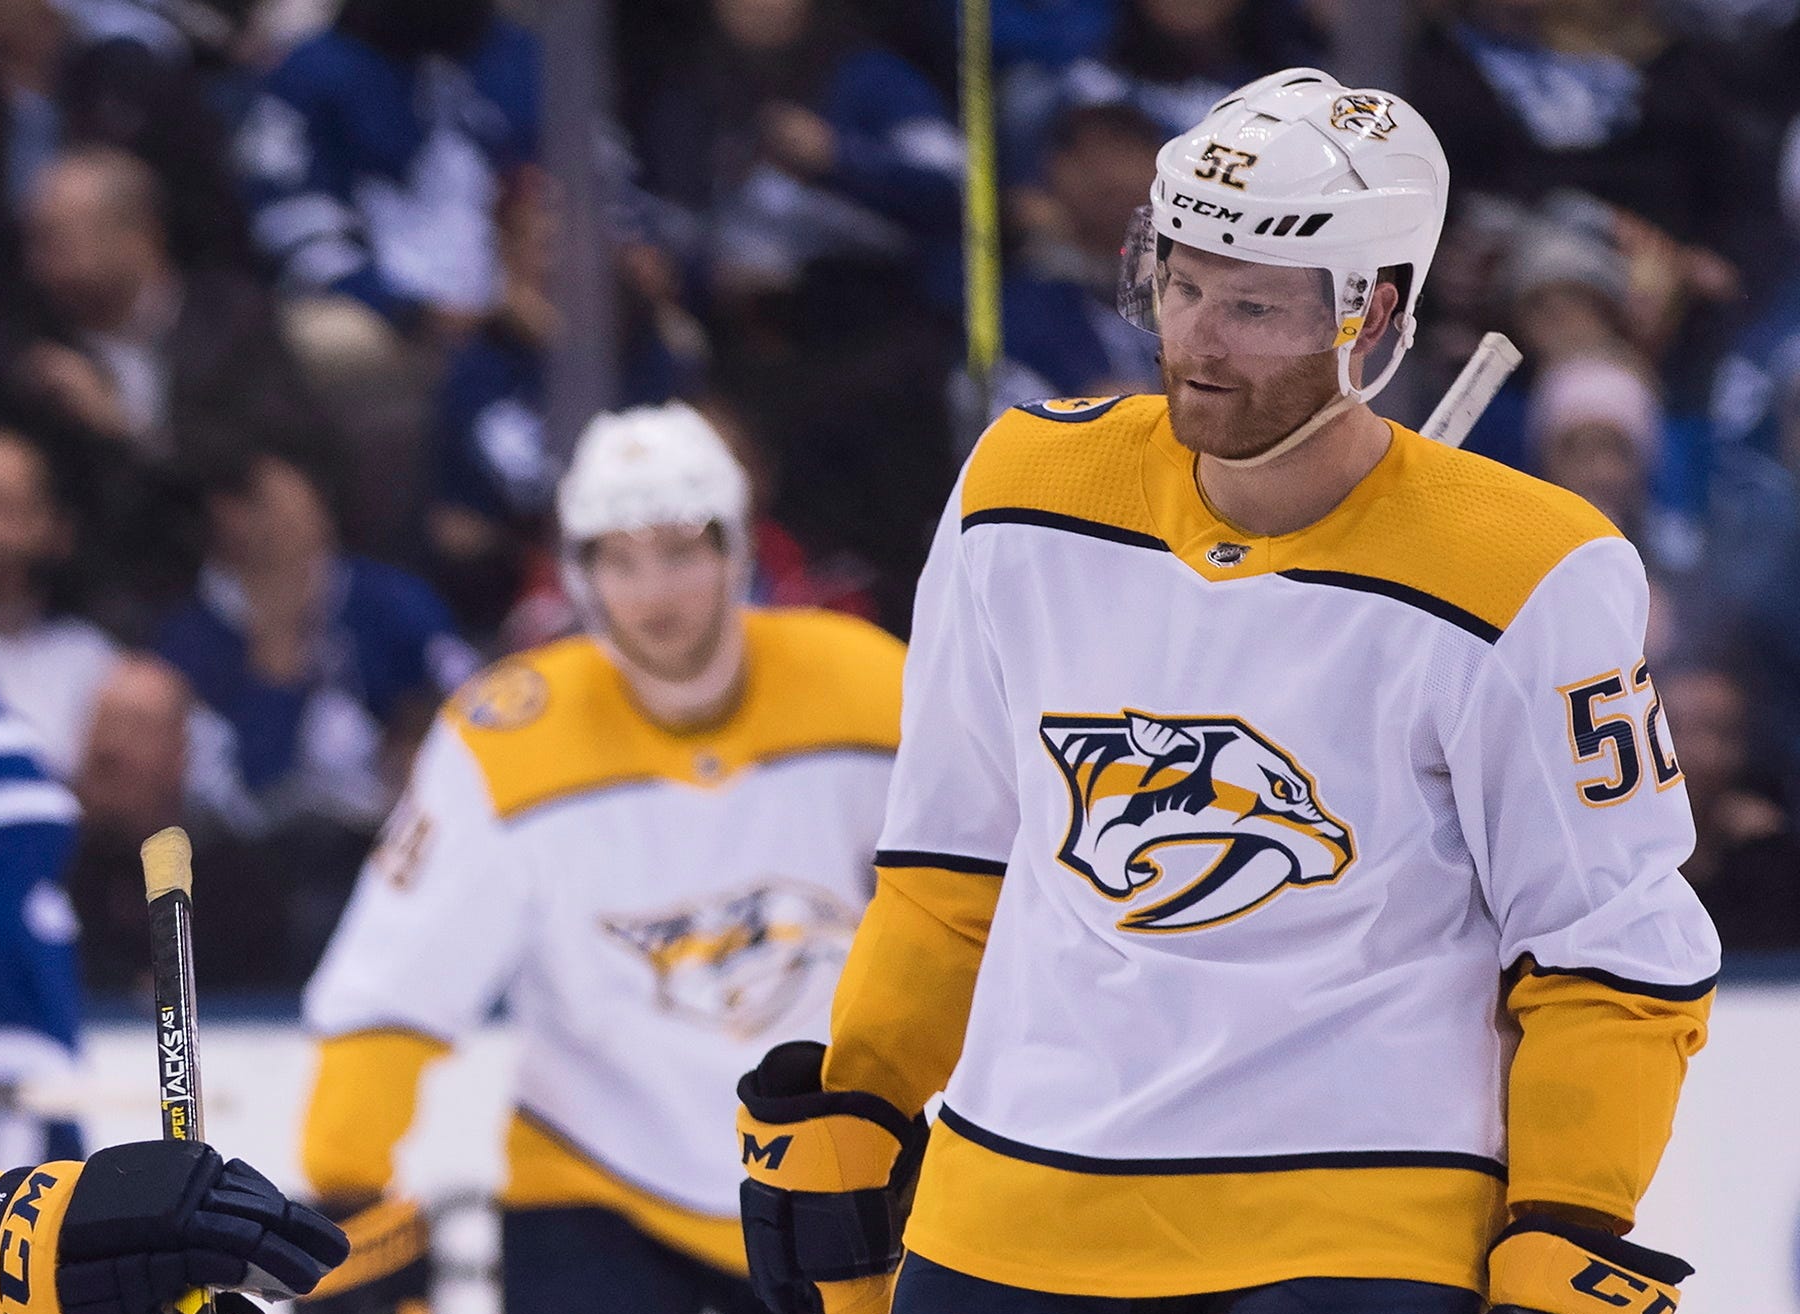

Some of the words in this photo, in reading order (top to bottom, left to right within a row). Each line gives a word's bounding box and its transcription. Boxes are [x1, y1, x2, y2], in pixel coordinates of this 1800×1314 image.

[1193, 143, 1257, 192] 52
[1172, 192, 1243, 223] CCM
[161, 1006, 175, 1030] AS1
[159, 1029, 195, 1102] TACKS
